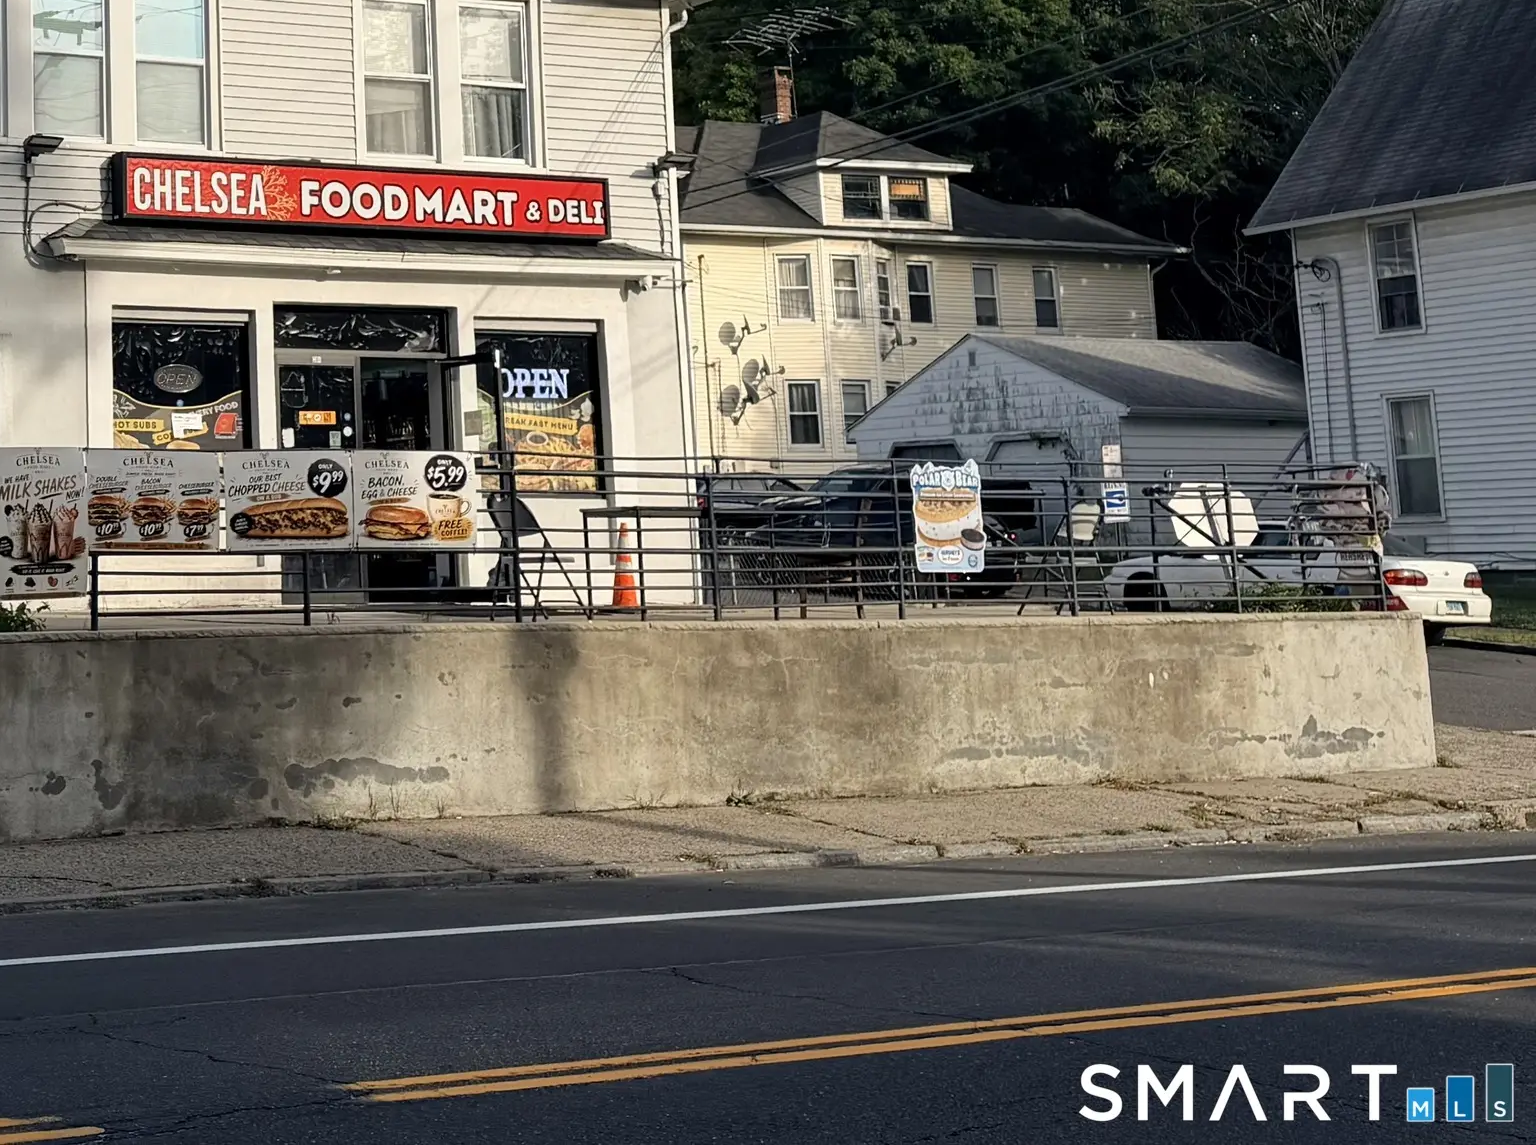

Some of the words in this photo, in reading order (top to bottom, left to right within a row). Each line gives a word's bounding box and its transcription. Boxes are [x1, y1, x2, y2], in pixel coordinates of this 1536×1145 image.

[133, 166, 267, 216] CHELSEA
[300, 180, 409, 220] FOOD
[415, 187, 518, 226] MART
[525, 201, 540, 222] &
[547, 197, 604, 225] DELI
[157, 372, 198, 386] OPEN
[501, 368, 570, 399] OPEN
[214, 401, 239, 413] FOOD
[133, 421, 157, 429] SUBS
[550, 420, 574, 430] MENU
[15, 455, 61, 466] CHELSEA
[122, 456, 174, 468] CHELSEA
[242, 460, 290, 470] CHELSEA
[364, 459, 410, 470] CHELSEA
[95, 475, 118, 483] DOUBLE
[248, 475, 263, 484] OUR
[264, 473, 283, 482] BEST
[912, 471, 941, 487] POLAR
[955, 470, 979, 487] BEAR
[33, 474, 77, 497] SHAKES
[228, 483, 271, 497] CHOPPED
[271, 481, 306, 493] CHEESE
[65, 486, 85, 501] NOW!
[361, 489, 378, 500] EGG
[386, 486, 418, 497] CHEESE
[438, 519, 463, 531] FREE
